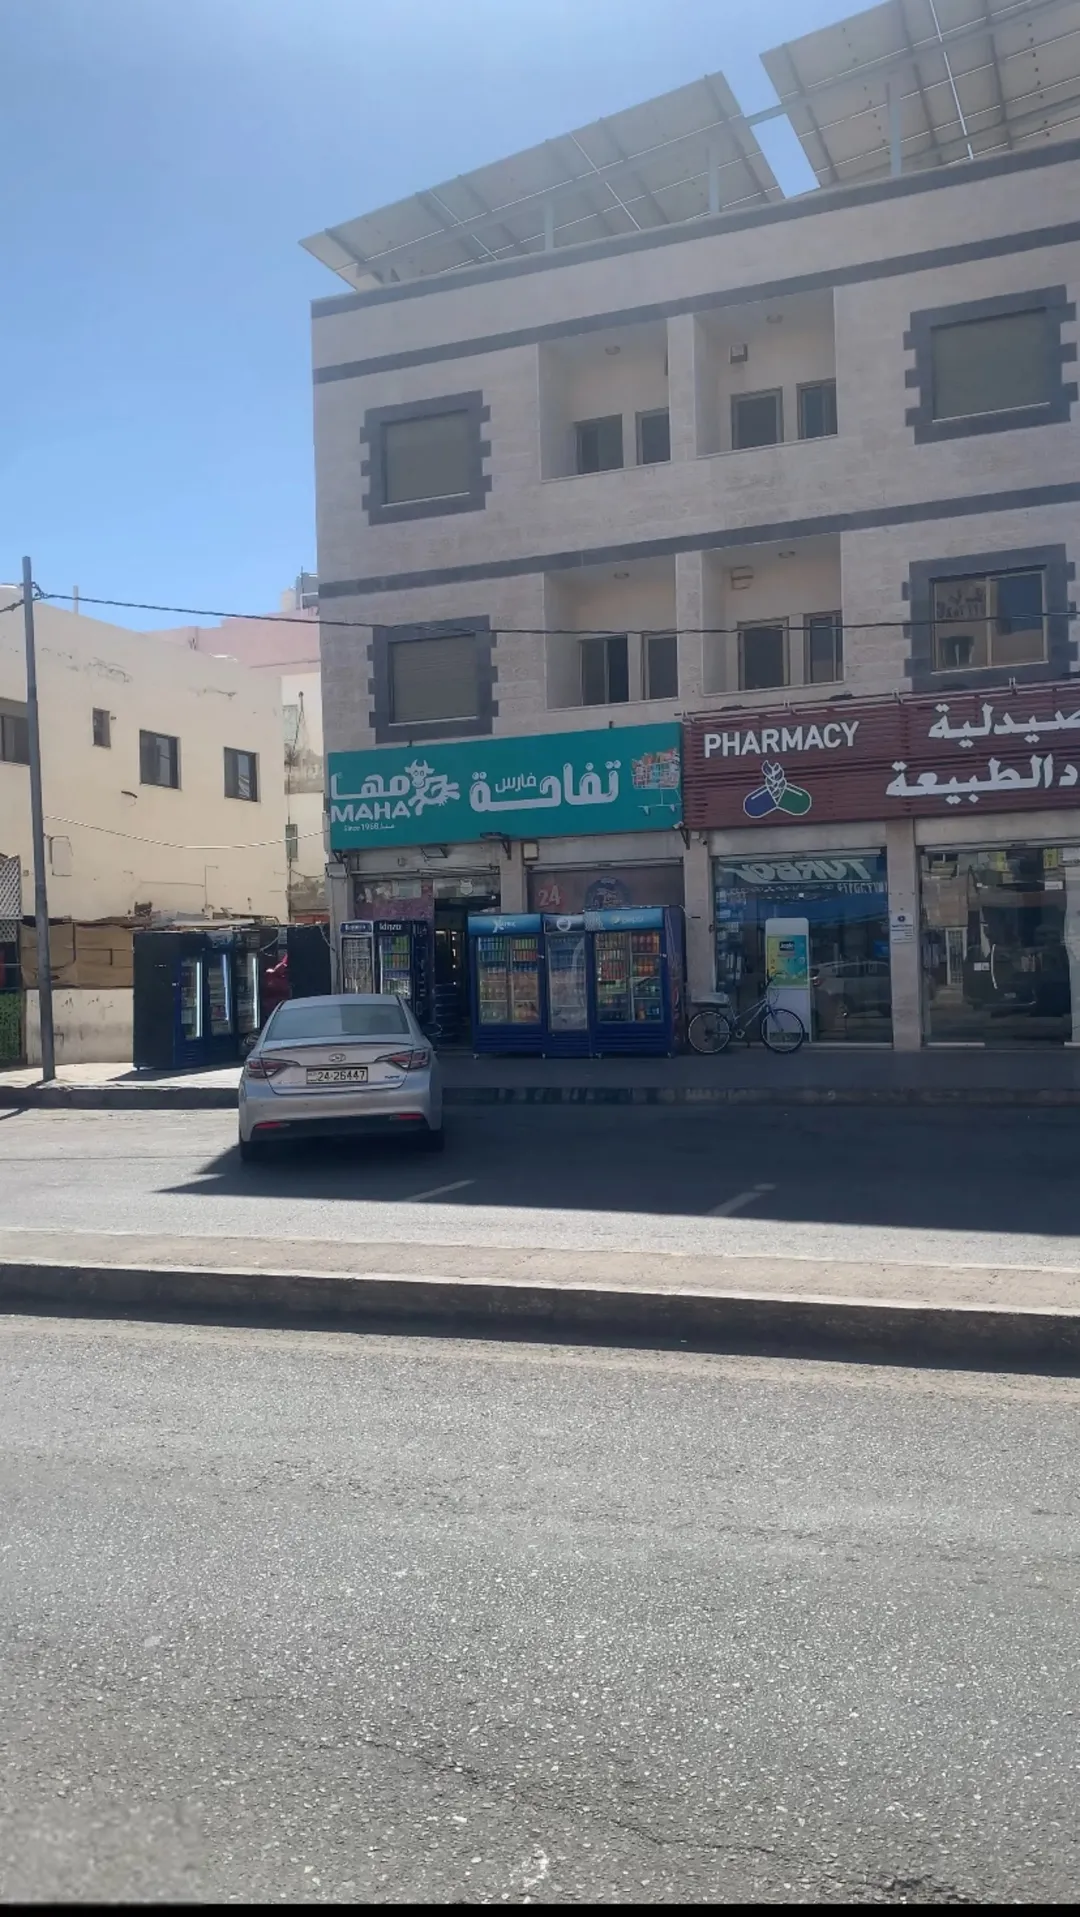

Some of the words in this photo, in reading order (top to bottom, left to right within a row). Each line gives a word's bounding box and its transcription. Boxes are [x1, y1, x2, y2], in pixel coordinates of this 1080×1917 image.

[704, 721, 859, 758] PHARMACY
[331, 773, 410, 800] مها
[469, 760, 621, 812] تفاحة
[495, 772, 537, 794] فارس
[886, 753, 1054, 804] الطبيعة
[331, 801, 411, 823] MAHA
[538, 885, 561, 906] 24
